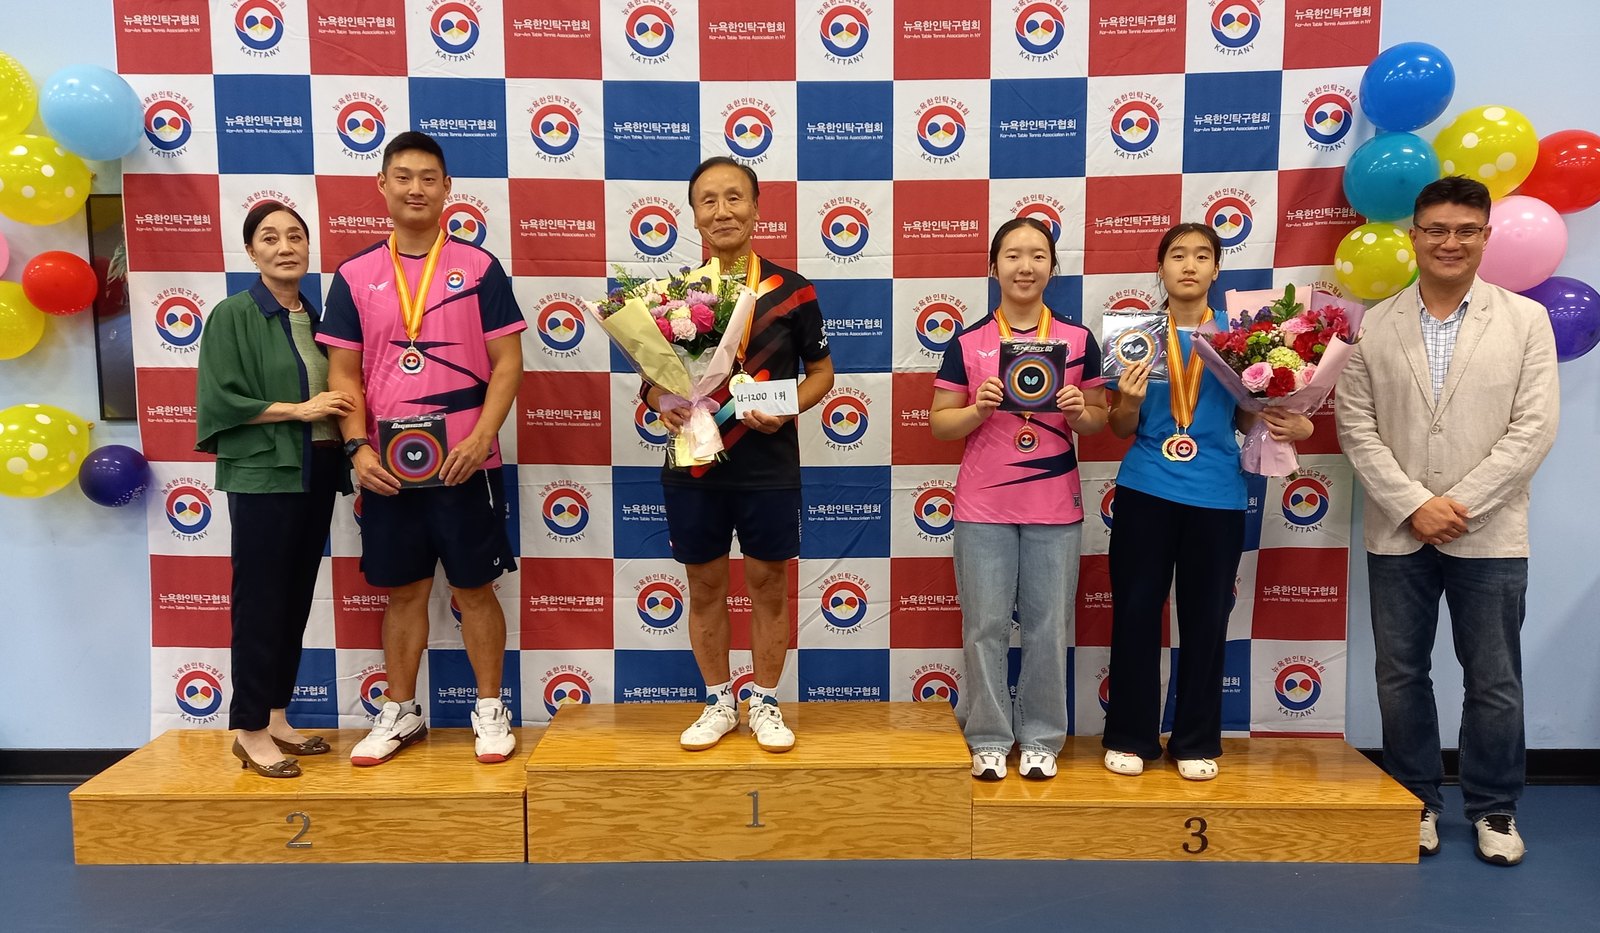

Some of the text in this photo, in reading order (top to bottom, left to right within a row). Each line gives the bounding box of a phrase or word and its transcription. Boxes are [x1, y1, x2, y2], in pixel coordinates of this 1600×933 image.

[1295, 7, 1371, 19] 뉴욕한인탁구협회
[124, 15, 199, 25] 뉴욕한인탁구협회
[318, 16, 395, 27] 뉴욕한인탁구협회
[514, 19, 590, 30] 뉴욕한인탁구협회
[904, 20, 980, 31] 뉴욕한인탁구협회
[1099, 15, 1176, 27] 뉴욕한인탁구협회
[709, 22, 785, 32] 뉴욕한인탁구협회
[239, 46, 281, 58] KATTANY
[435, 49, 476, 62] KATTANY
[1214, 43, 1255, 56] KATTANY
[629, 52, 670, 65] KATTANY
[824, 52, 865, 65] KATTANY
[1019, 50, 1059, 63] KATTANY
[1302, 84, 1358, 105] 뉴욕한인탁구협회
[332, 91, 387, 112] 뉴욕한인탁구협회
[526, 95, 583, 115] 뉴욕한인탁구협회
[720, 97, 776, 118] 뉴욕한인탁구협회
[914, 95, 970, 116] 뉴욕한인탁구협회
[1108, 91, 1164, 112] 뉴욕한인탁구협회
[226, 116, 302, 126] 뉴욕한인탁구협회
[420, 119, 496, 130] 뉴욕한인탁구협회
[1000, 120, 1076, 130] 뉴욕한인탁구협회
[1194, 113, 1270, 125] 뉴욕한인탁구협회
[614, 122, 689, 133] 뉴욕한인탁구협회
[807, 123, 882, 133] 뉴욕한인탁구협회
[149, 146, 188, 159] KATTANY
[1307, 139, 1347, 153] KATTANY
[341, 147, 383, 161] KATTANY
[535, 151, 576, 164] KATTANY
[920, 152, 961, 165] KATTANY
[1113, 147, 1154, 160] KATTANY
[241, 190, 297, 210] 뉴욕한인탁구협회
[1010, 194, 1065, 213] 뉴욕한인탁구협회
[1201, 188, 1257, 208] 뉴욕한인탁구협회
[625, 196, 681, 217] 뉴욕한인탁구협회
[817, 196, 873, 217] 뉴욕한인탁구협회
[136, 214, 210, 225] 뉴욕한인탁구협회
[1286, 208, 1357, 220] 뉴욕한인탁구협회
[520, 219, 595, 230] 뉴욕한인탁구협회
[903, 221, 978, 231] 뉴욕한인탁구협회
[1095, 216, 1170, 227] 뉴욕한인탁구협회
[633, 250, 674, 263] KATTANY
[824, 250, 865, 264] KATTANY
[151, 287, 206, 307] 뉴욕한인탁구협회
[533, 292, 588, 312] 뉴욕한인탁구협회
[912, 293, 967, 314] 뉴욕한인탁구협회
[1103, 289, 1158, 309] 뉴욕한인탁구협회
[159, 342, 201, 355] KATTANY
[541, 346, 581, 359] KATTANY
[737, 392, 767, 402] U-1200
[818, 386, 872, 406] 뉴욕한인탁구협회
[526, 409, 600, 420] 뉴욕한인탁구협회
[638, 440, 667, 452] KATTA
[824, 439, 864, 452] KATTANY
[161, 477, 214, 496] 뉴욕한인탁구협회
[538, 479, 592, 499] 뉴욕한인탁구협회
[808, 504, 880, 514] 뉴욕한인탁구협회
[1283, 521, 1323, 533] KATTANY
[171, 529, 209, 542] KATTANY
[545, 531, 586, 543] KATTANY
[633, 573, 688, 592] 뉴욕한인탁구협회
[817, 572, 871, 592] 뉴욕한인탁구협회
[1264, 586, 1337, 596] 뉴욕한인탁구협회
[160, 594, 229, 604] 뉴욕한인탁구협회
[530, 596, 603, 606] 뉴욕한인탁구협회
[639, 624, 680, 636] KATTANY
[823, 623, 863, 635] KATTANY
[1271, 655, 1326, 674] 뉴욕한인탁구협회
[171, 662, 225, 681] 뉴욕한인탁구협회
[540, 664, 594, 683] 뉴욕한인탁구협회
[909, 663, 962, 681] 뉴욕한인탁구협회
[624, 687, 696, 697] 뉴욕한인탁구협회
[808, 687, 879, 697] 뉴욕한인탁구협회
[179, 712, 220, 724] KATTANY
[1277, 705, 1317, 718] KATTANY
[745, 790, 766, 828] 1
[286, 811, 312, 848] 2
[1182, 816, 1208, 854] 3
